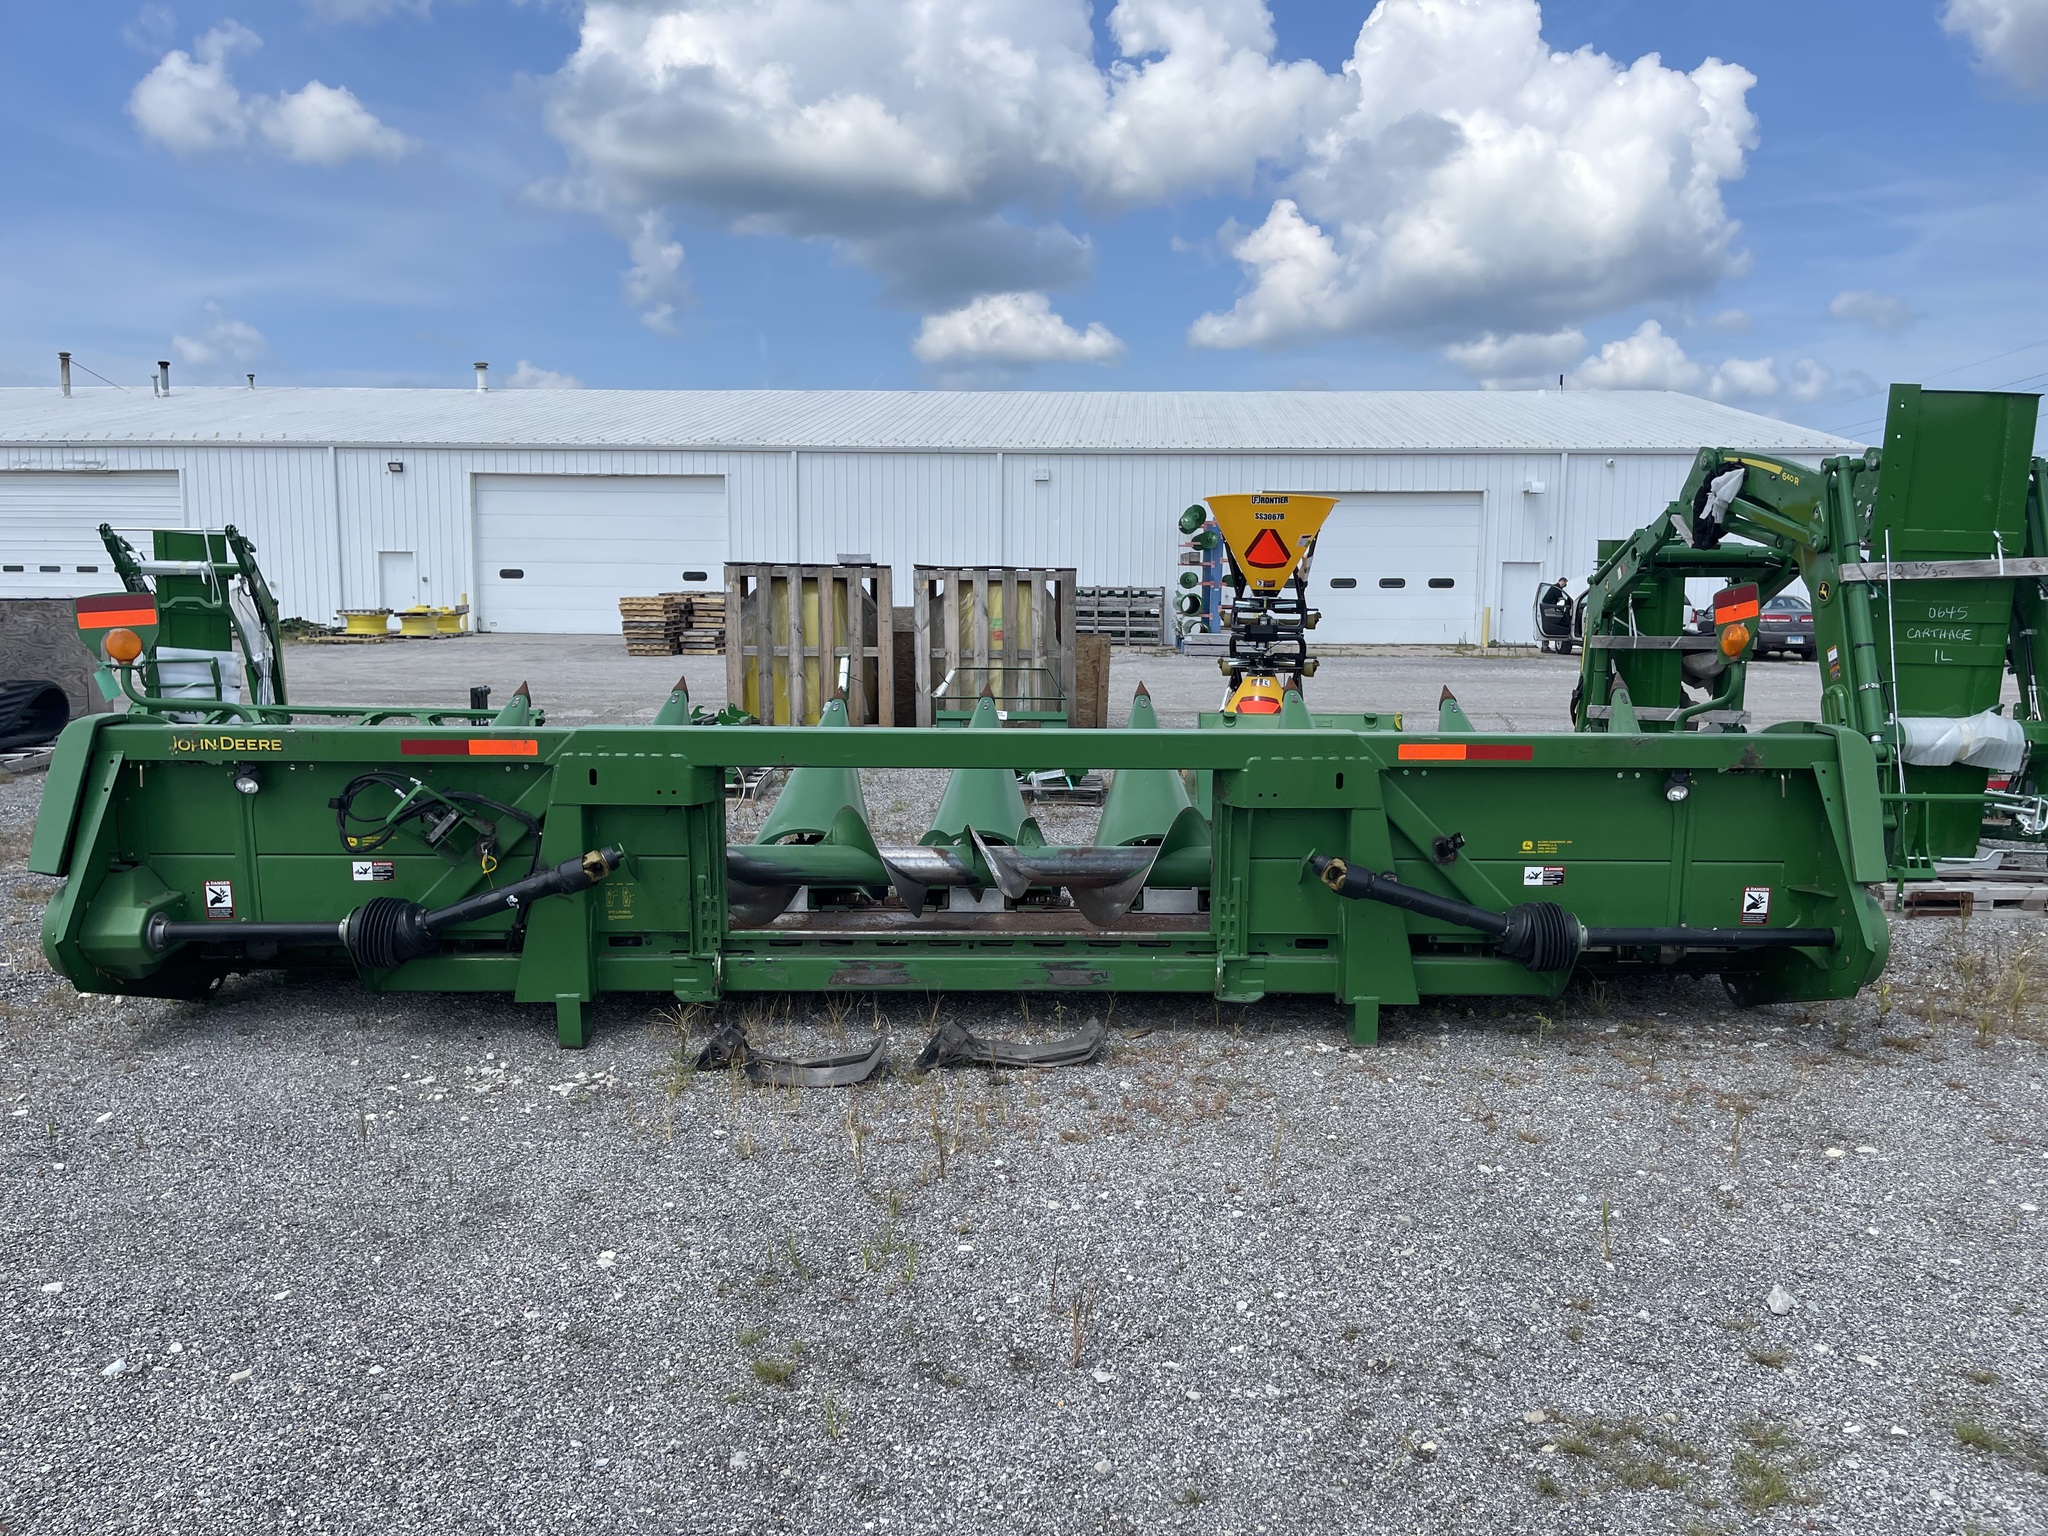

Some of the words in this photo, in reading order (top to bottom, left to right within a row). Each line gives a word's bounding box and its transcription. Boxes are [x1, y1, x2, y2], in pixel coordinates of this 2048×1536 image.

[1781, 472, 1800, 487] 640R
[1251, 495, 1289, 504] FRONTIER
[1928, 606, 1969, 620] 0645
[1906, 628, 1972, 641] CARTHAGE
[220, 736, 282, 751] DEERE
